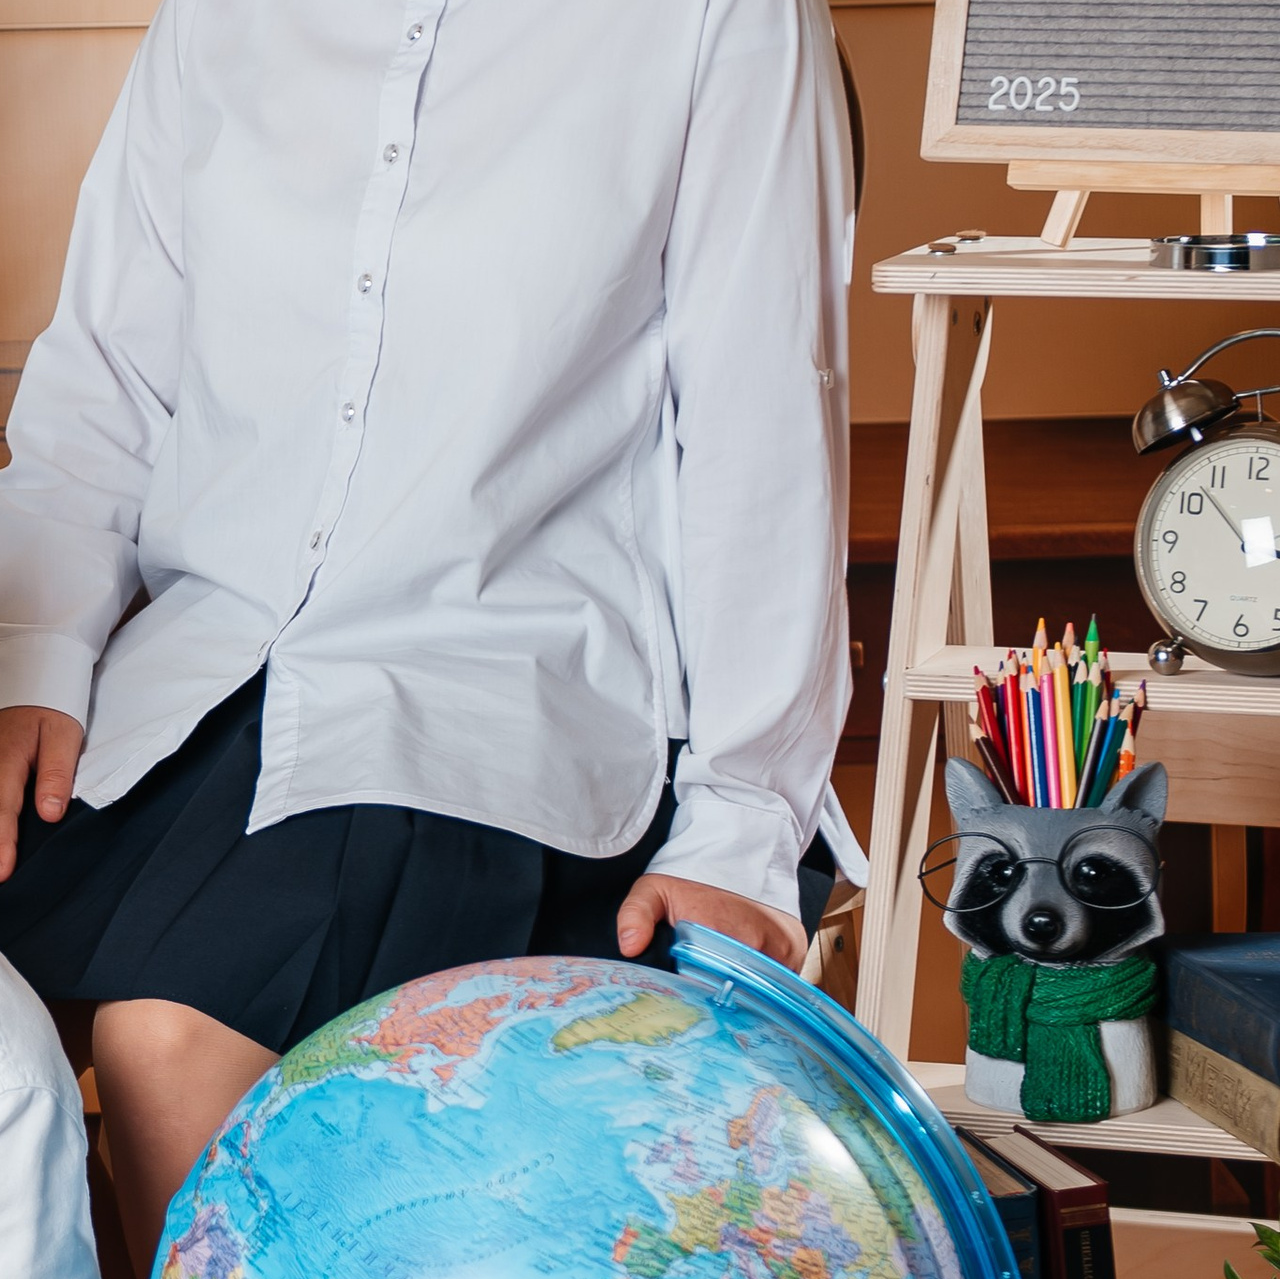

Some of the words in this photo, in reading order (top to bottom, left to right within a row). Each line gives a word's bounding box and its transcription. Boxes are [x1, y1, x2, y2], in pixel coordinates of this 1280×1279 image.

[987, 75, 1081, 112] 2025
[1210, 465, 1226, 489] 11
[1248, 456, 1270, 481] 12
[1179, 491, 1204, 515] 10
[1162, 530, 1179, 554] 9
[1169, 570, 1186, 594] 8
[1193, 598, 1209, 622] 7
[1232, 614, 1250, 638] 6
